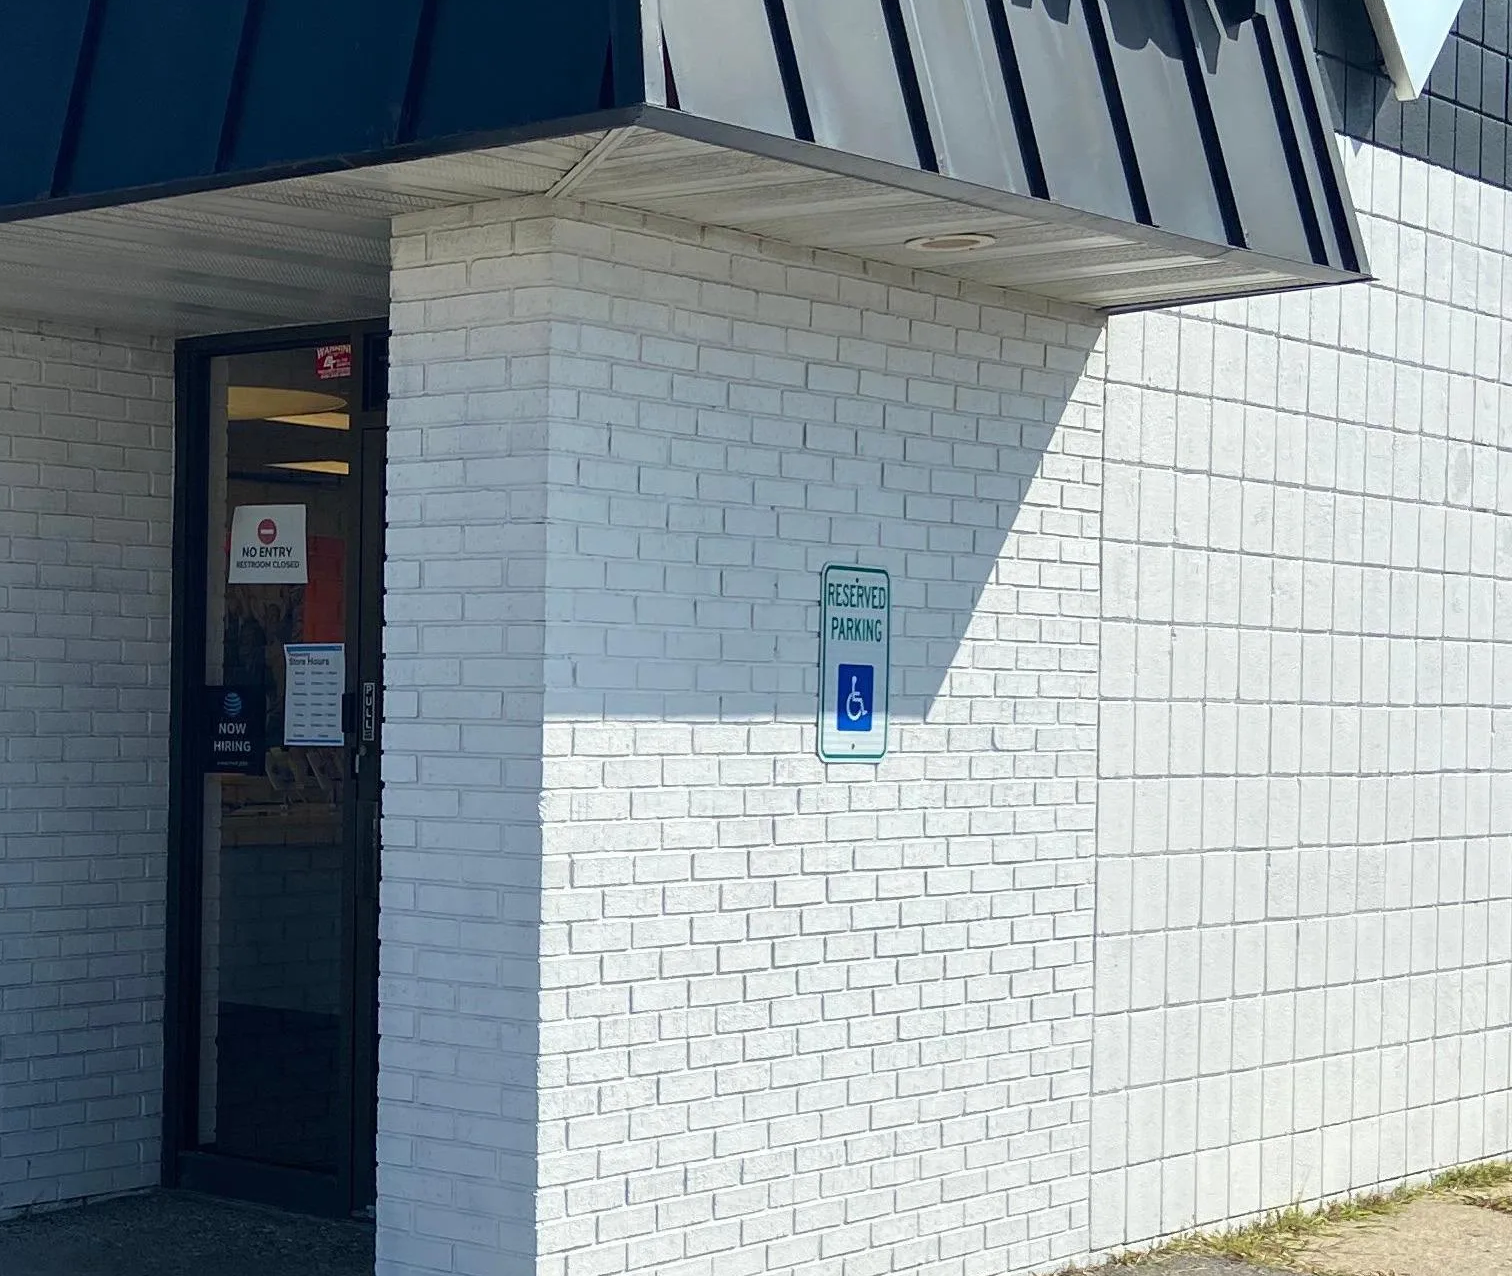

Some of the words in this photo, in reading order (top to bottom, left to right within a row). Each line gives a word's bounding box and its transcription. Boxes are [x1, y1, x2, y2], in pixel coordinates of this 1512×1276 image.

[242, 546, 257, 558] NO
[259, 546, 293, 558] ENTRY
[236, 560, 271, 569] RESTROOM
[272, 560, 300, 569] CLOSED
[827, 583, 886, 610] RESERVED
[831, 616, 883, 643] PARKING
[365, 685, 373, 730] PULL
[218, 722, 247, 734] NOW
[213, 740, 252, 752] HIRING
